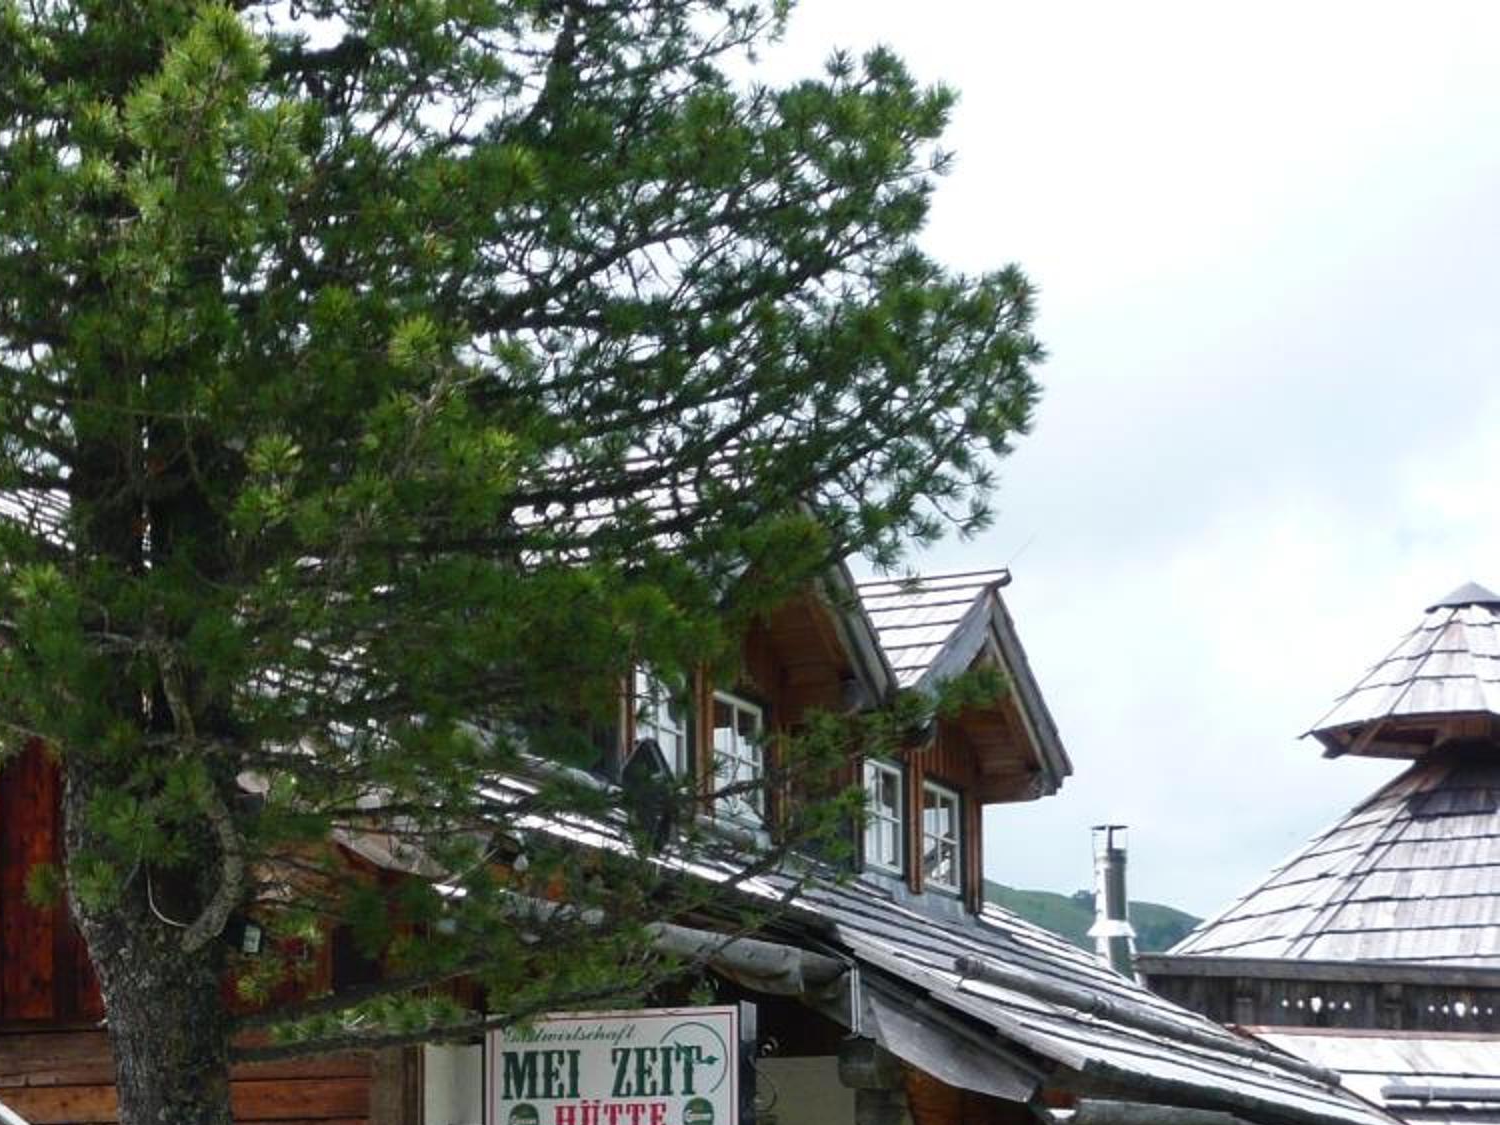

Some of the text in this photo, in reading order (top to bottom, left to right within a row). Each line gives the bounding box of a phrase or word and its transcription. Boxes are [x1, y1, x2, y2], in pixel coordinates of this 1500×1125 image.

[503, 1023, 636, 1046] Gtwirtschaft
[502, 1045, 702, 1100] MEI ZEIT
